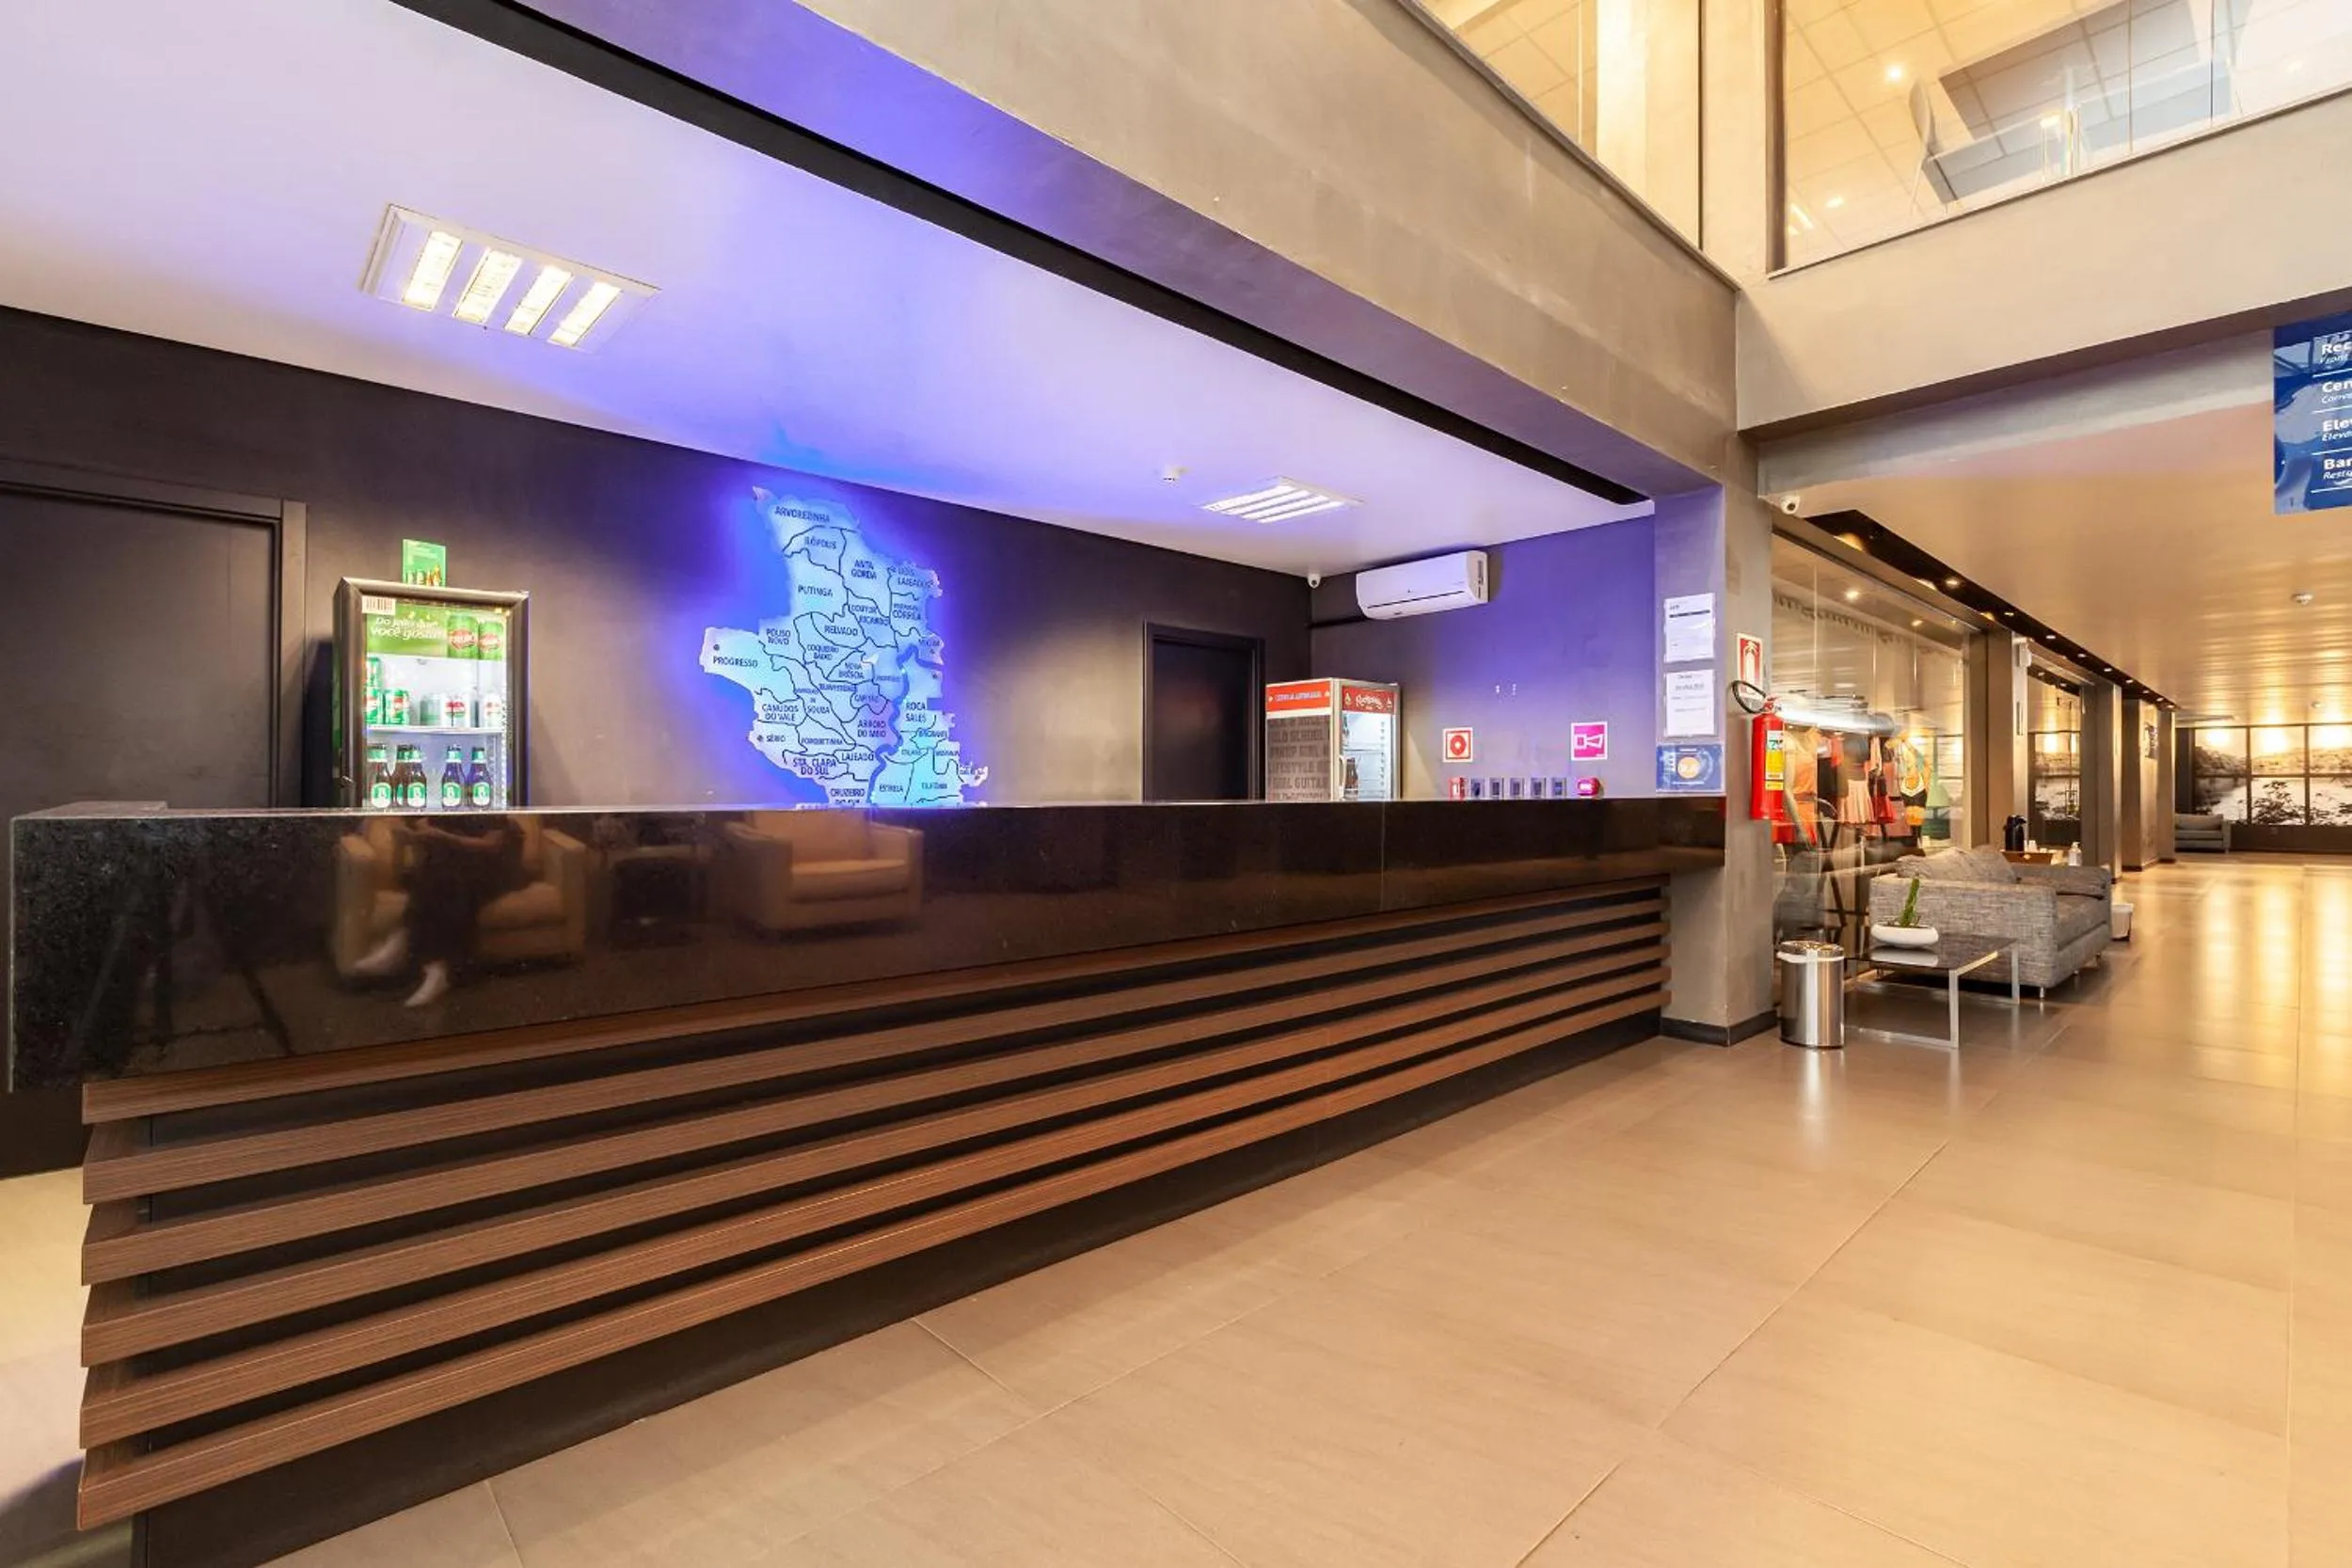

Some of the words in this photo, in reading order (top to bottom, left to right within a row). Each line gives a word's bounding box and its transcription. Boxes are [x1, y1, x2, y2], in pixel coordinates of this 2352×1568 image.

[775, 506, 831, 523] ARVOREZINHA
[854, 559, 875, 571] ANTA
[850, 569, 878, 580] GORDA
[798, 585, 834, 597] PUTINGA
[766, 627, 791, 638] POUSO
[824, 625, 859, 637] RELVADO
[768, 637, 789, 646] NOVO
[713, 656, 759, 669] PROGRESSO
[906, 702, 926, 711] ROCA
[905, 713, 927, 722] SALES
[841, 752, 875, 762] LAJEADO
[801, 767, 814, 775] DO
[815, 767, 829, 775] SUL
